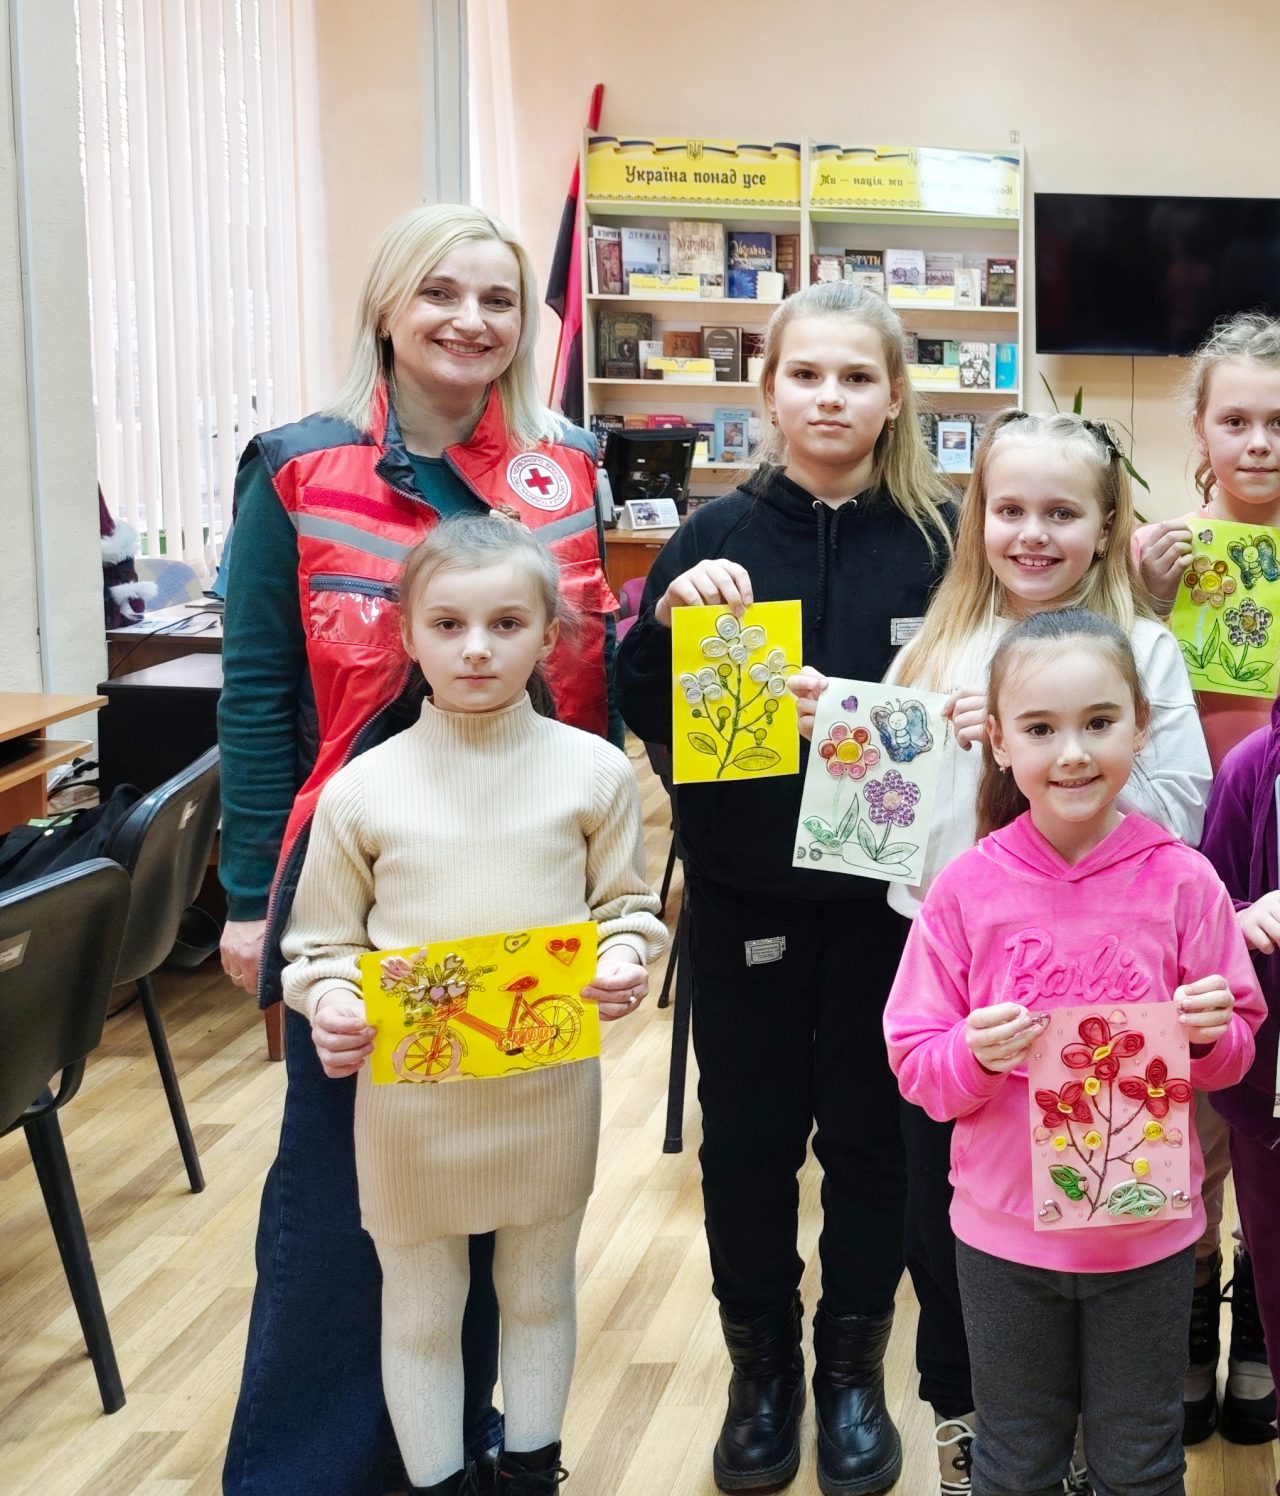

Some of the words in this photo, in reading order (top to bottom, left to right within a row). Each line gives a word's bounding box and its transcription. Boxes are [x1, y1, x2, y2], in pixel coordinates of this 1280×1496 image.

[625, 165, 688, 186] Україна
[694, 169, 737, 185] понад
[742, 173, 766, 189] усе
[819, 174, 836, 186] Ми
[628, 231, 668, 240] ДЕРЖАВА
[1001, 927, 1153, 1007] Barbie
